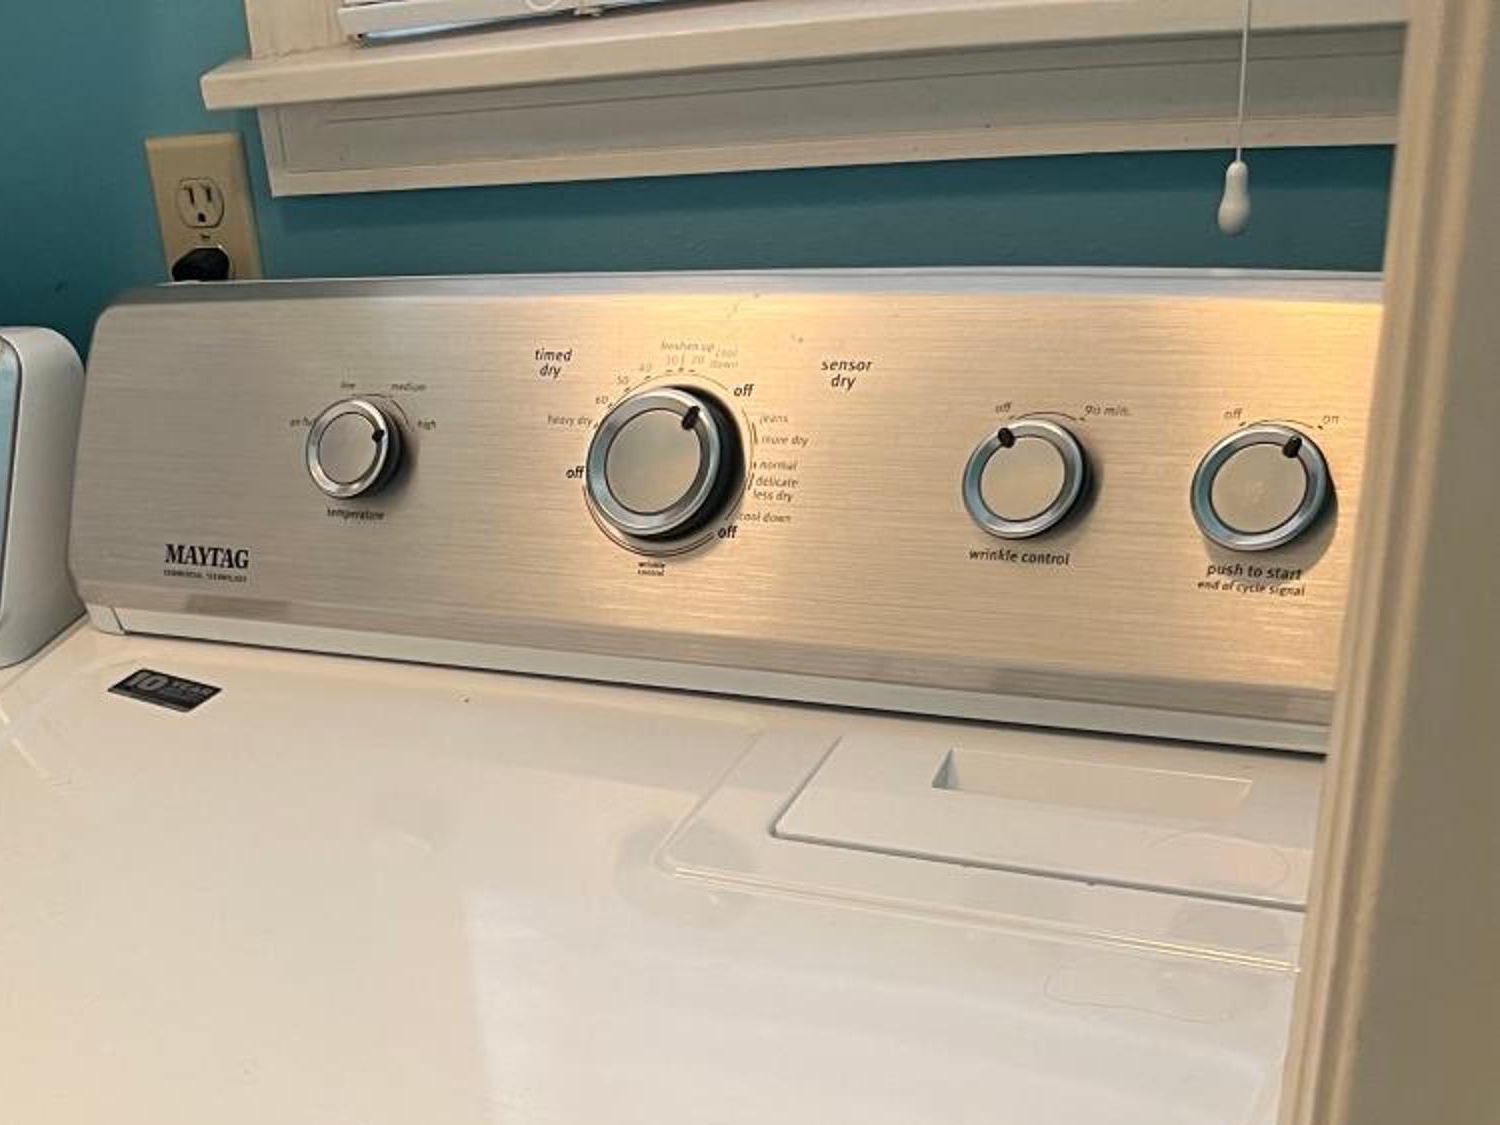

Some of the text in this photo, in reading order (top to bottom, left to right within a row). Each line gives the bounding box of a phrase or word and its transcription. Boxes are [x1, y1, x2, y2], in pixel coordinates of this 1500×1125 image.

[660, 341, 698, 351] freshen
[535, 348, 572, 361] timed
[539, 364, 561, 378] dry
[821, 359, 872, 372] sensor
[831, 372, 856, 390] dry
[733, 383, 754, 398] off
[547, 413, 592, 427] heavy dry
[1224, 407, 1243, 421] off
[1322, 412, 1340, 424] on
[791, 434, 809, 448] dry
[760, 460, 798, 470] normal
[565, 465, 585, 480] off
[756, 476, 798, 488] delicate
[754, 489, 792, 503] less dry
[327, 508, 385, 522] temperature
[763, 512, 791, 523] down
[717, 525, 738, 539] off
[164, 544, 249, 569] MAYTAG
[969, 549, 1071, 565] wrinkle control
[1206, 563, 1302, 580] push to start
[1197, 580, 1305, 597] end of cycle signal
